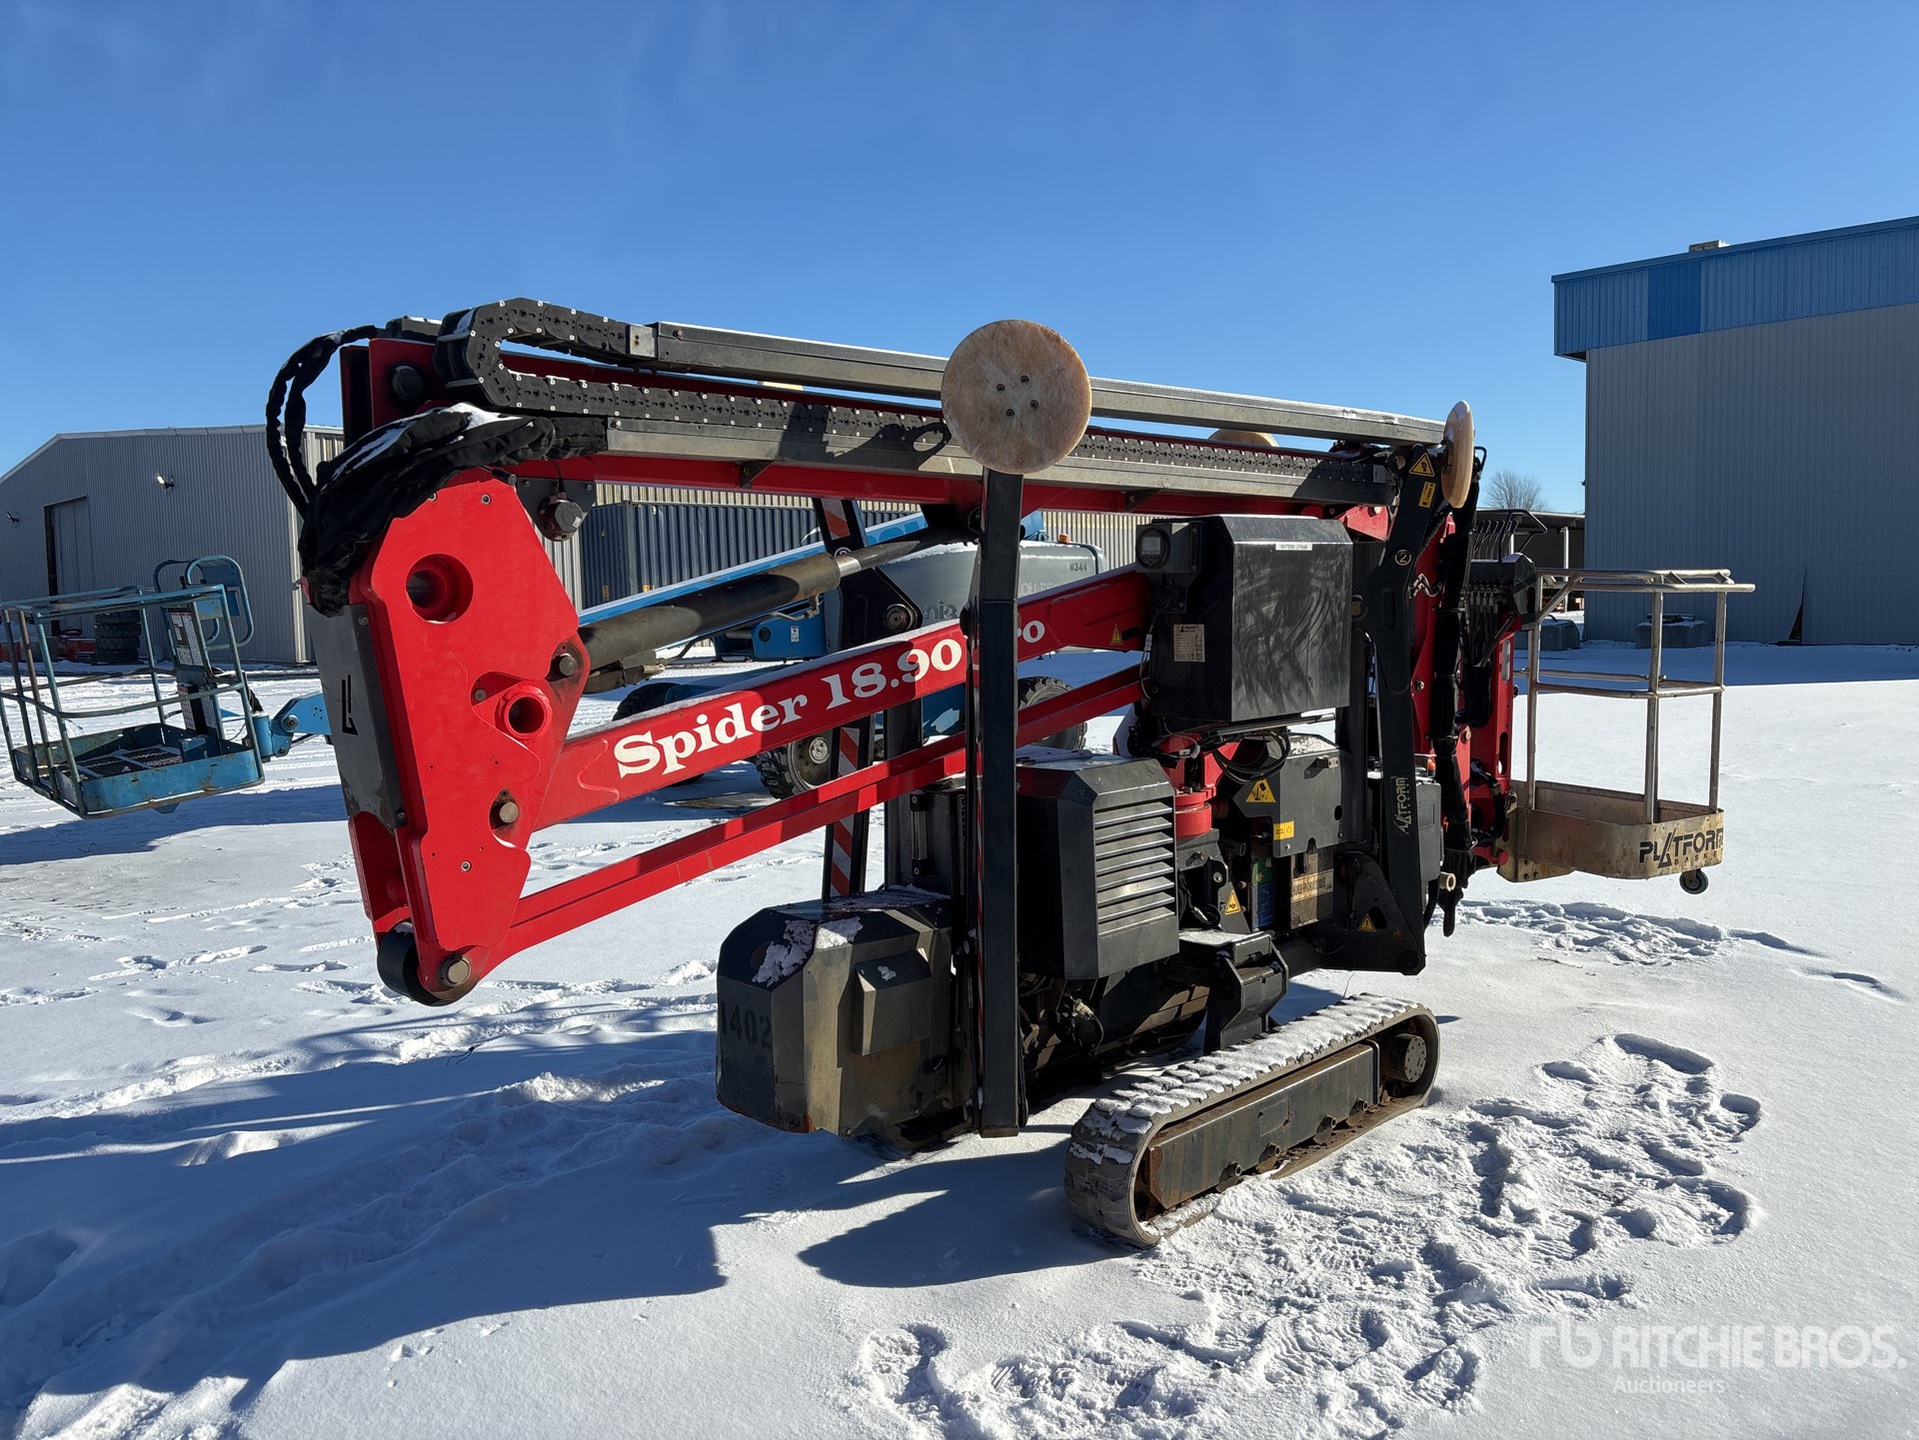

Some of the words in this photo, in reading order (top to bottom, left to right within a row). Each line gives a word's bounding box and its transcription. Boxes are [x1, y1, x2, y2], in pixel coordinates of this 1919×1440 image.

[923, 600, 958, 621] nie
[613, 693, 808, 779] Spider
[821, 638, 963, 710] 18.90
[1674, 851, 1718, 866] BASKE
[721, 1001, 773, 1050] 1402
